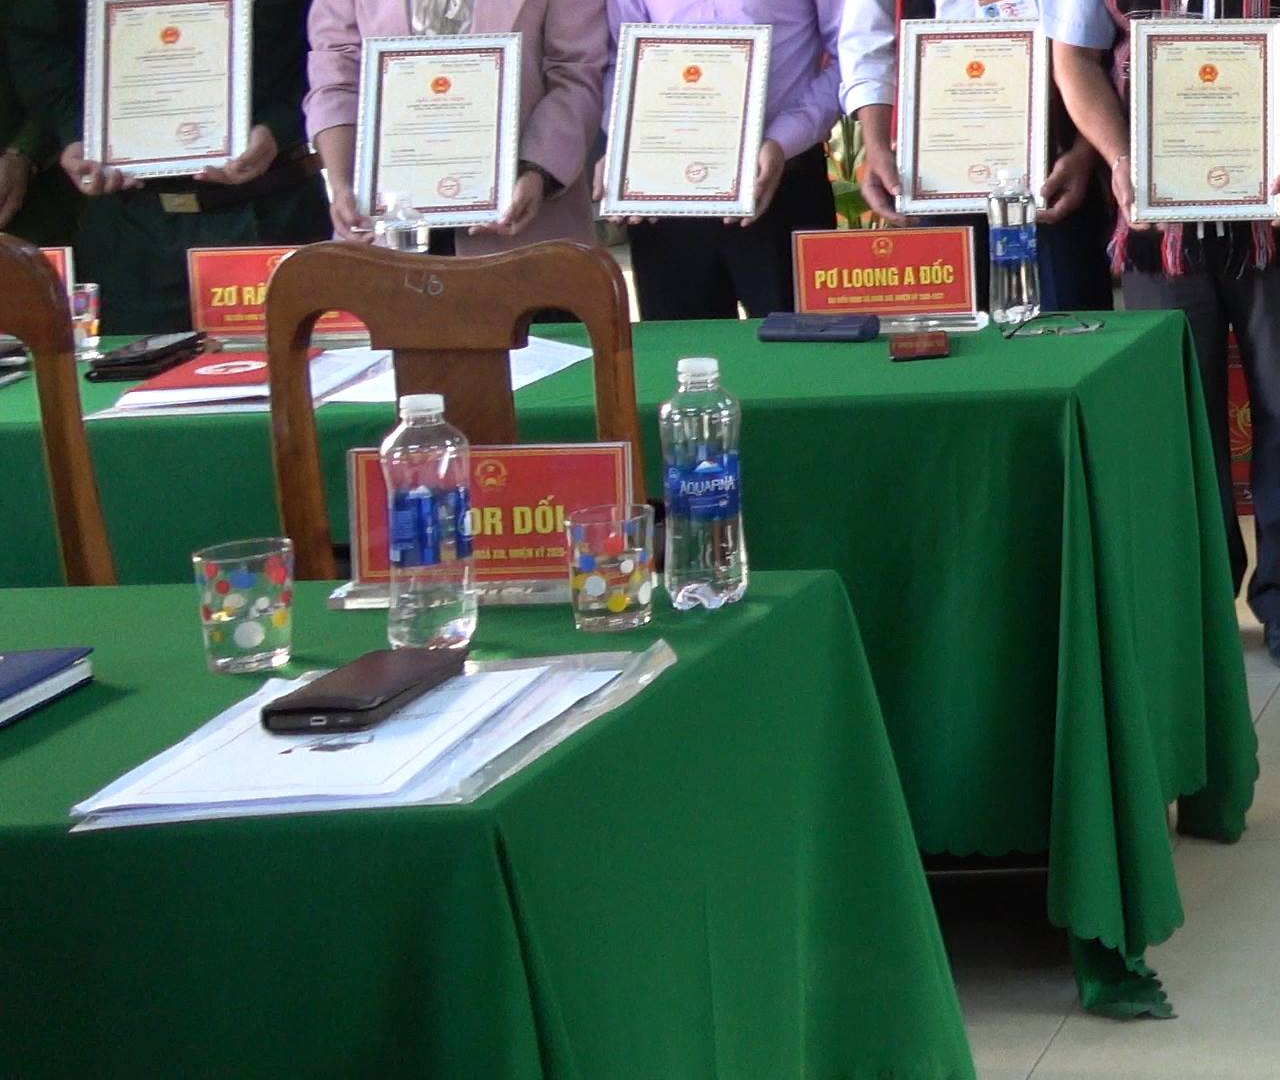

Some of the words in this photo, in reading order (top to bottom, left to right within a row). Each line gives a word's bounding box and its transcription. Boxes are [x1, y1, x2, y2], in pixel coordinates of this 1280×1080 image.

[814, 267, 838, 289] PƠ
[842, 266, 899, 288] LOONG
[904, 266, 915, 286] A
[919, 259, 955, 285] ĐỐC
